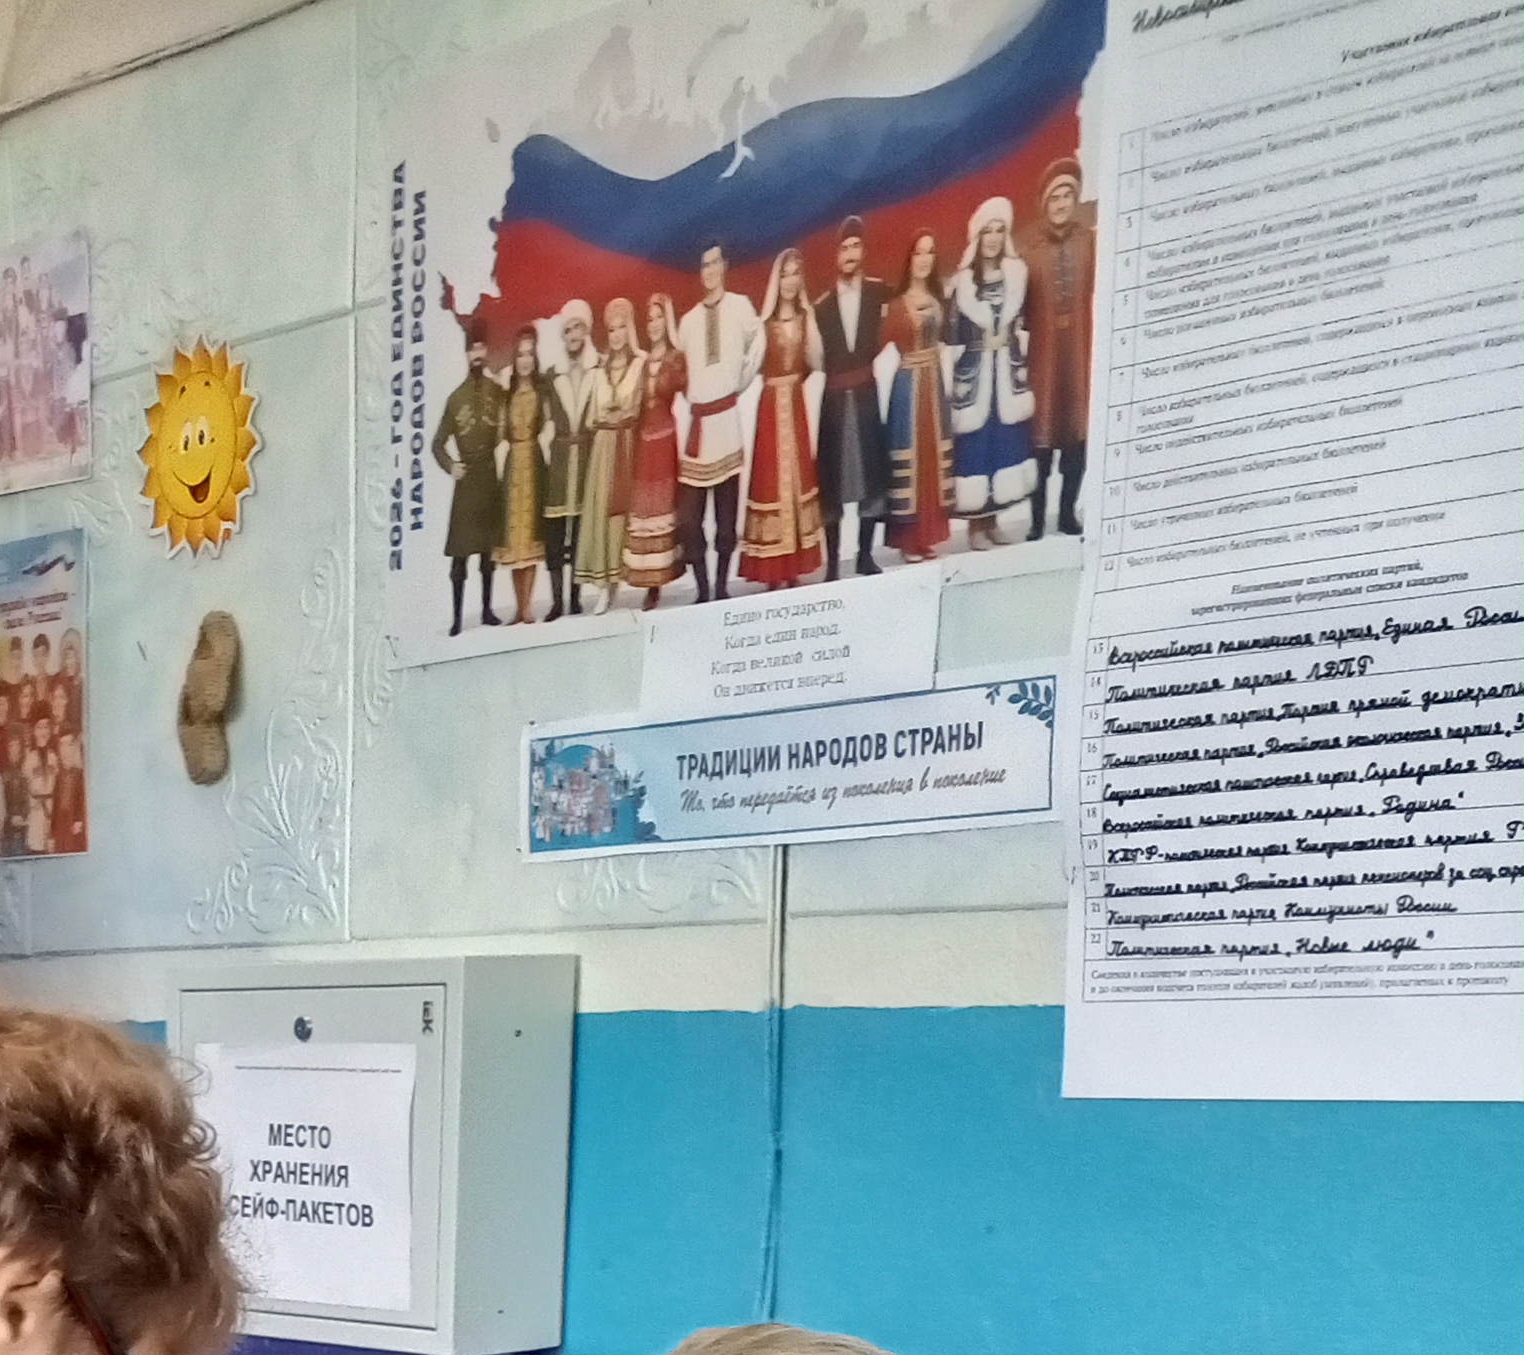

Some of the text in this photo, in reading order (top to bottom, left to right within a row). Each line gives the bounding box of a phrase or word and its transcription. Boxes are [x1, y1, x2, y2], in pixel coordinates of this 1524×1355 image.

[388, 160, 406, 362] ЕДИНСТВА
[409, 190, 427, 531] НАРОДОВ РОССИИ
[390, 370, 404, 446] ГОД
[389, 478, 403, 572] 2026
[676, 720, 984, 781] ТРАДИЦИИ НАРОДОВ СТРАНЫ
[680, 788, 706, 813] То,
[842, 778, 913, 799] поколения
[919, 766, 931, 792] в
[933, 768, 1007, 790] поколение
[268, 1123, 331, 1149] МЕСТО
[250, 1159, 350, 1189] ХРАНЕНИЯ
[228, 1192, 374, 1228] СЕЙФ-ПАКЕТОВ
